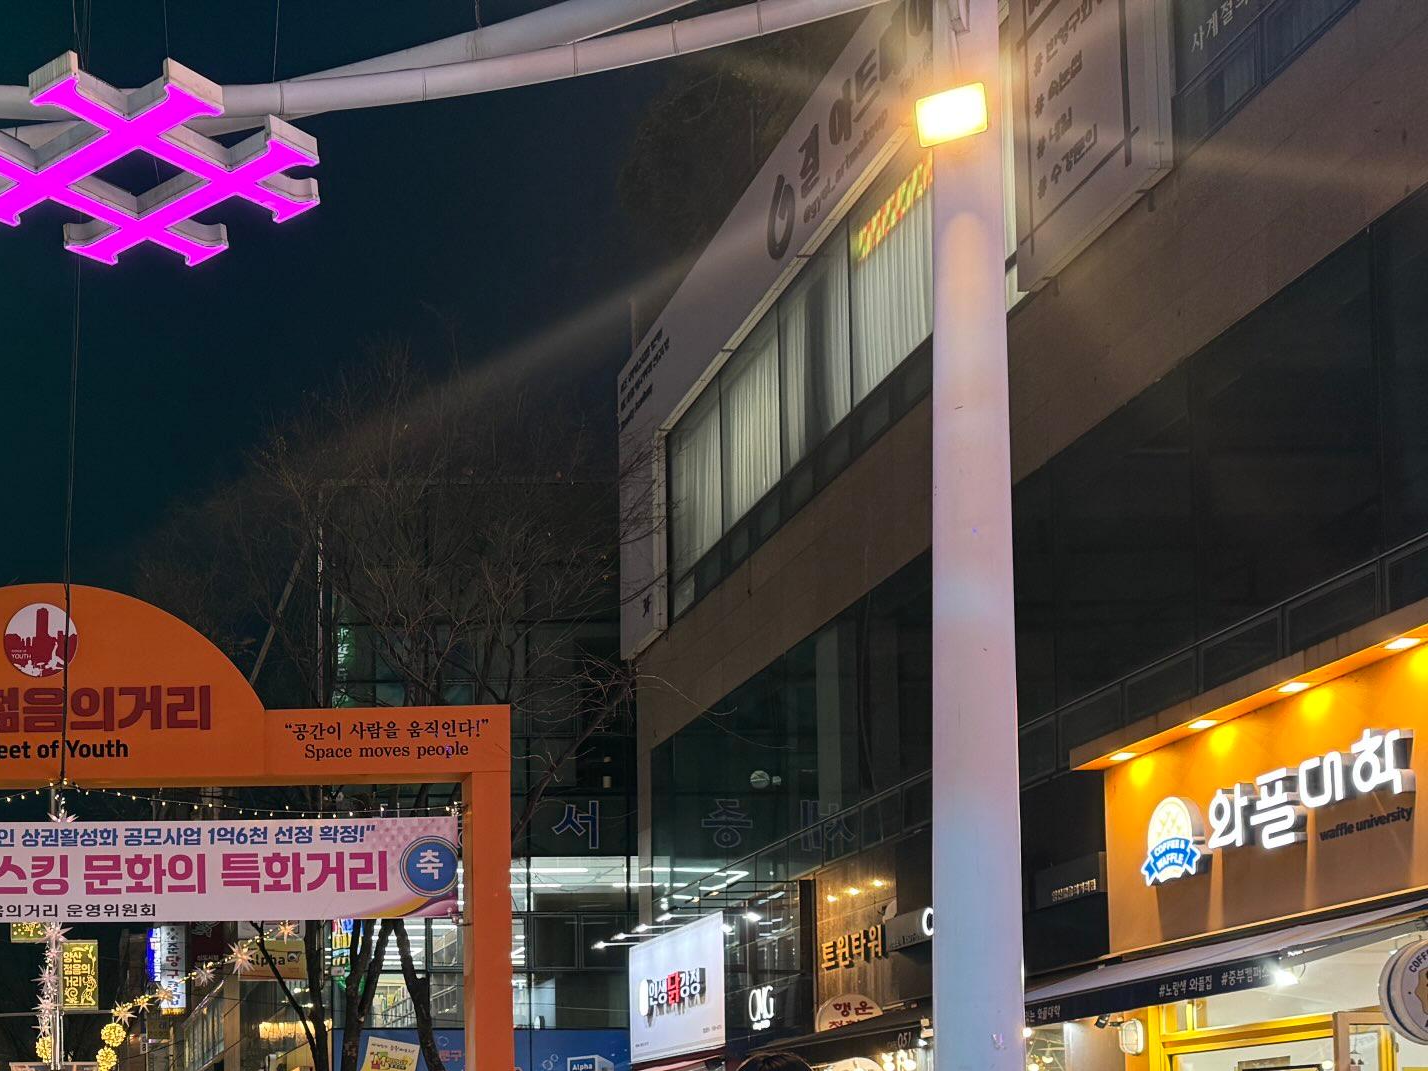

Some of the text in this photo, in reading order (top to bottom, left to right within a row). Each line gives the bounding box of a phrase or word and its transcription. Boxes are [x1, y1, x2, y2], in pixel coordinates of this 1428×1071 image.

[350, 720, 400, 740] 사람을
[36, 740, 60, 760] of
[65, 738, 129, 759] Youth
[304, 742, 469, 761] Space moves people
[1207, 728, 1405, 851] 와플대학
[1319, 805, 1414, 843] waffle university
[21, 827, 119, 848] 상권활성화
[123, 827, 204, 847] 공모사업
[208, 826, 268, 846] 1억6천
[274, 826, 314, 845] 선정
[83, 853, 207, 896] 문화의
[221, 850, 389, 894] 특화거리
[415, 849, 445, 880] 축
[66, 902, 157, 918] 운영위원회
[63, 951, 82, 963] 양산
[821, 924, 884, 969] 트윈타워
[63, 975, 82, 988] 거리
[572, 1062, 593, 1071] Alpha
